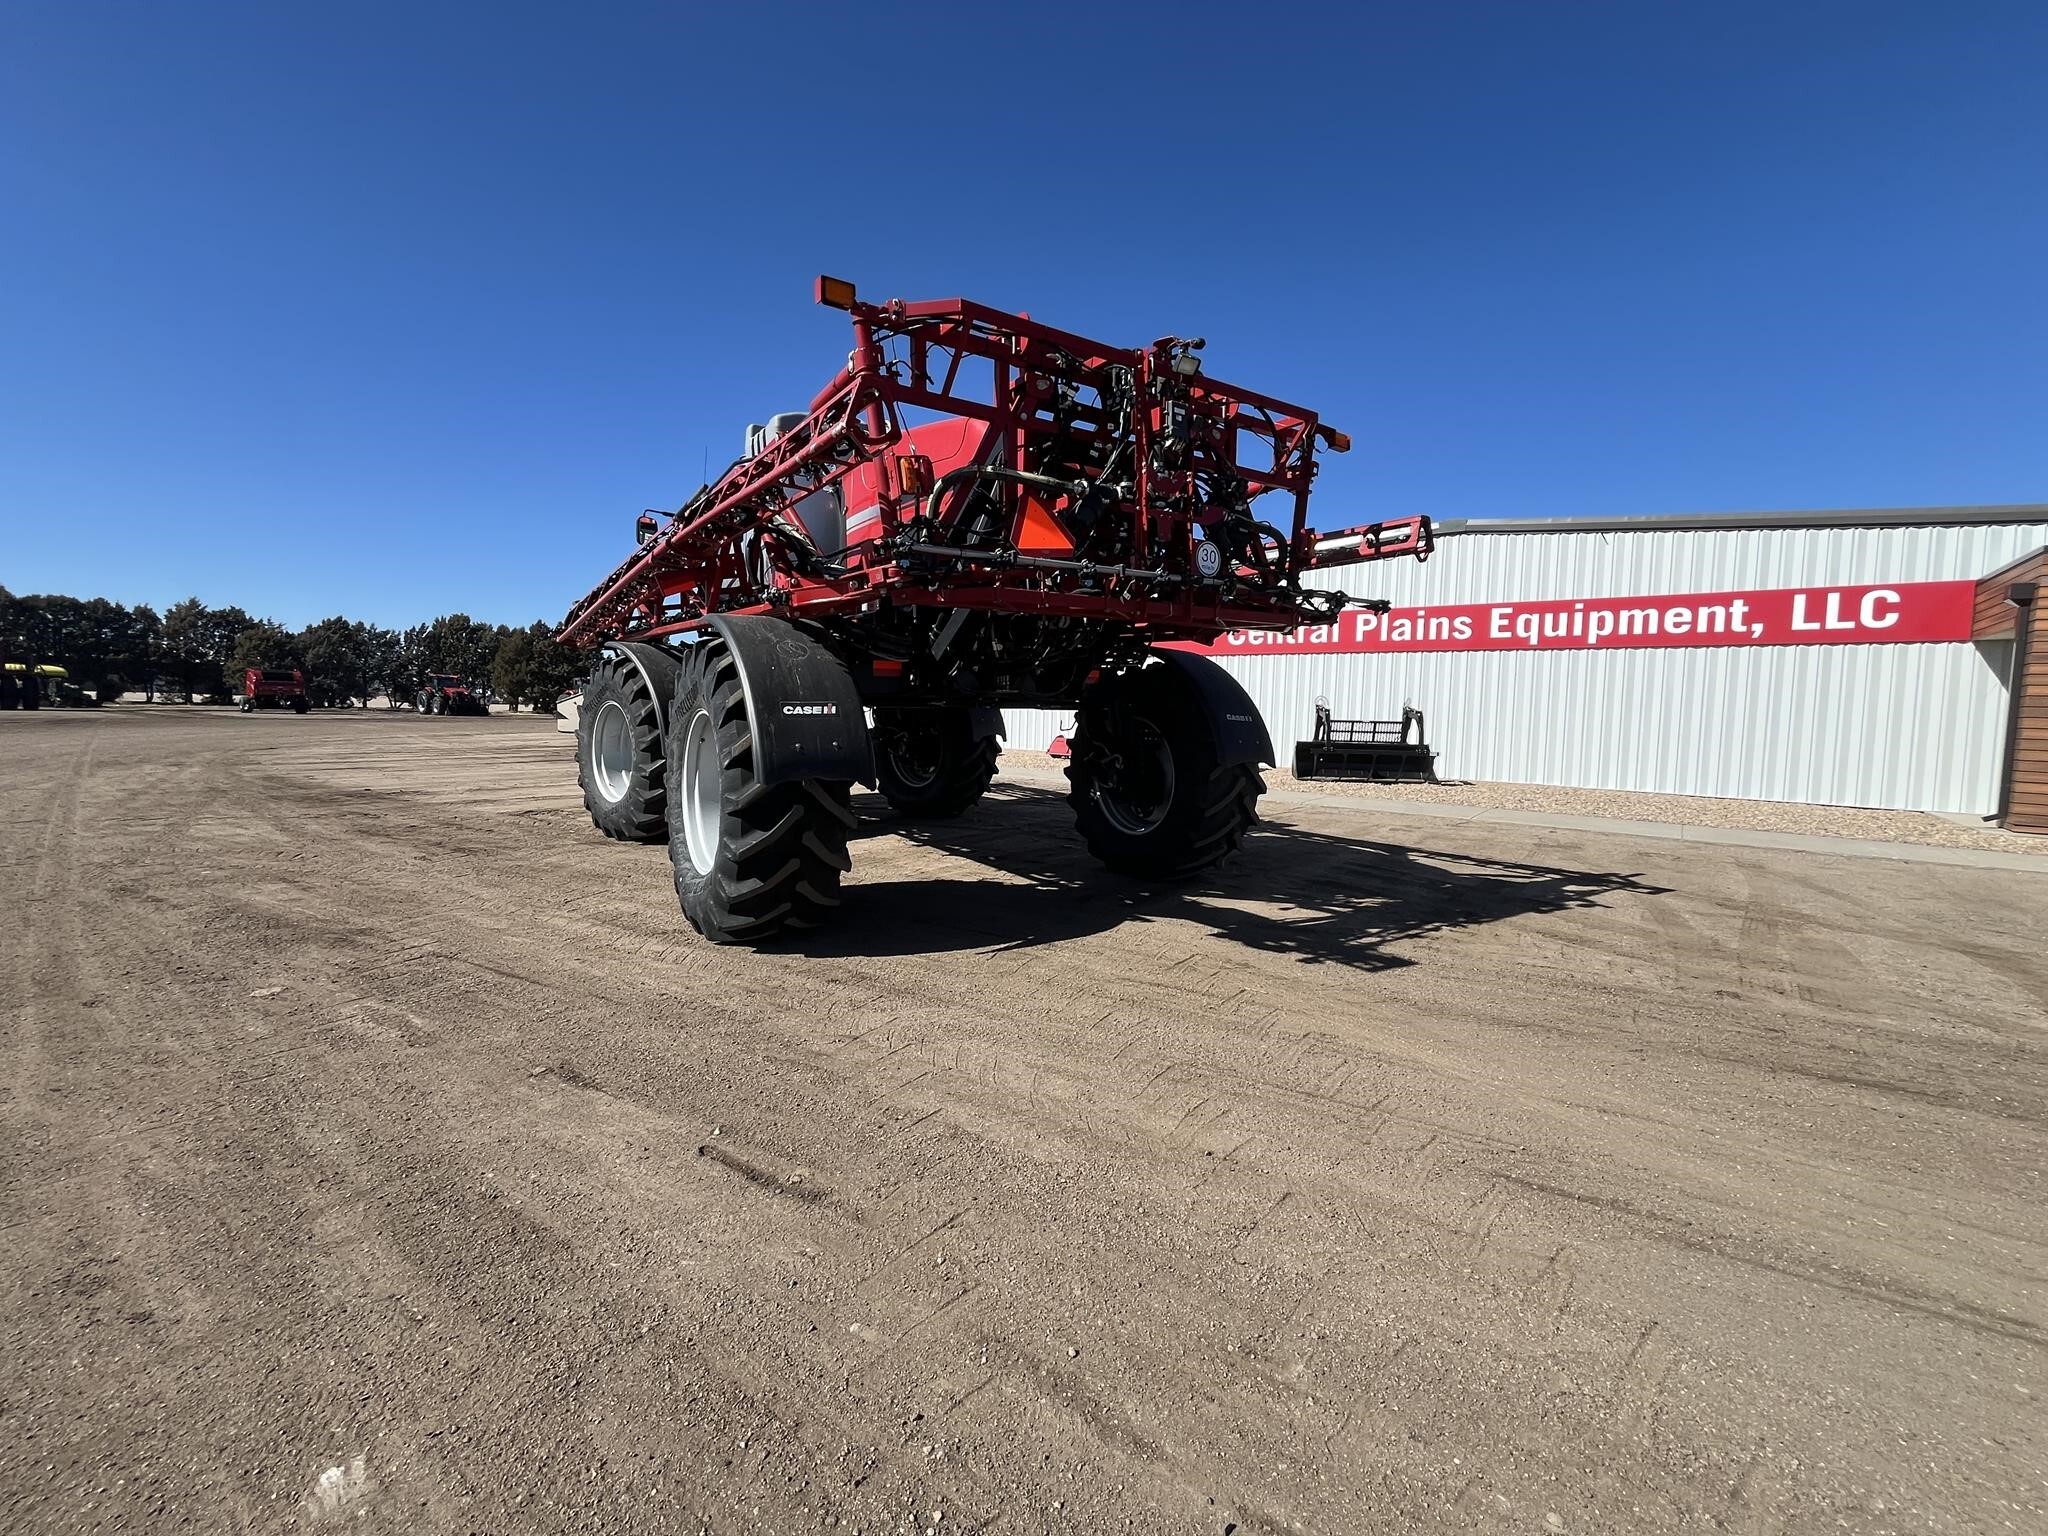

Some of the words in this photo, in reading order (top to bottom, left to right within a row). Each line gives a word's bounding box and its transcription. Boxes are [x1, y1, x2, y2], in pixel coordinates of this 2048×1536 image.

[1201, 548, 1217, 564] 30
[1355, 610, 1473, 642] Plains
[1489, 599, 1764, 646] Equipment,
[1791, 589, 1901, 631] LLC
[782, 705, 823, 715] CASE
